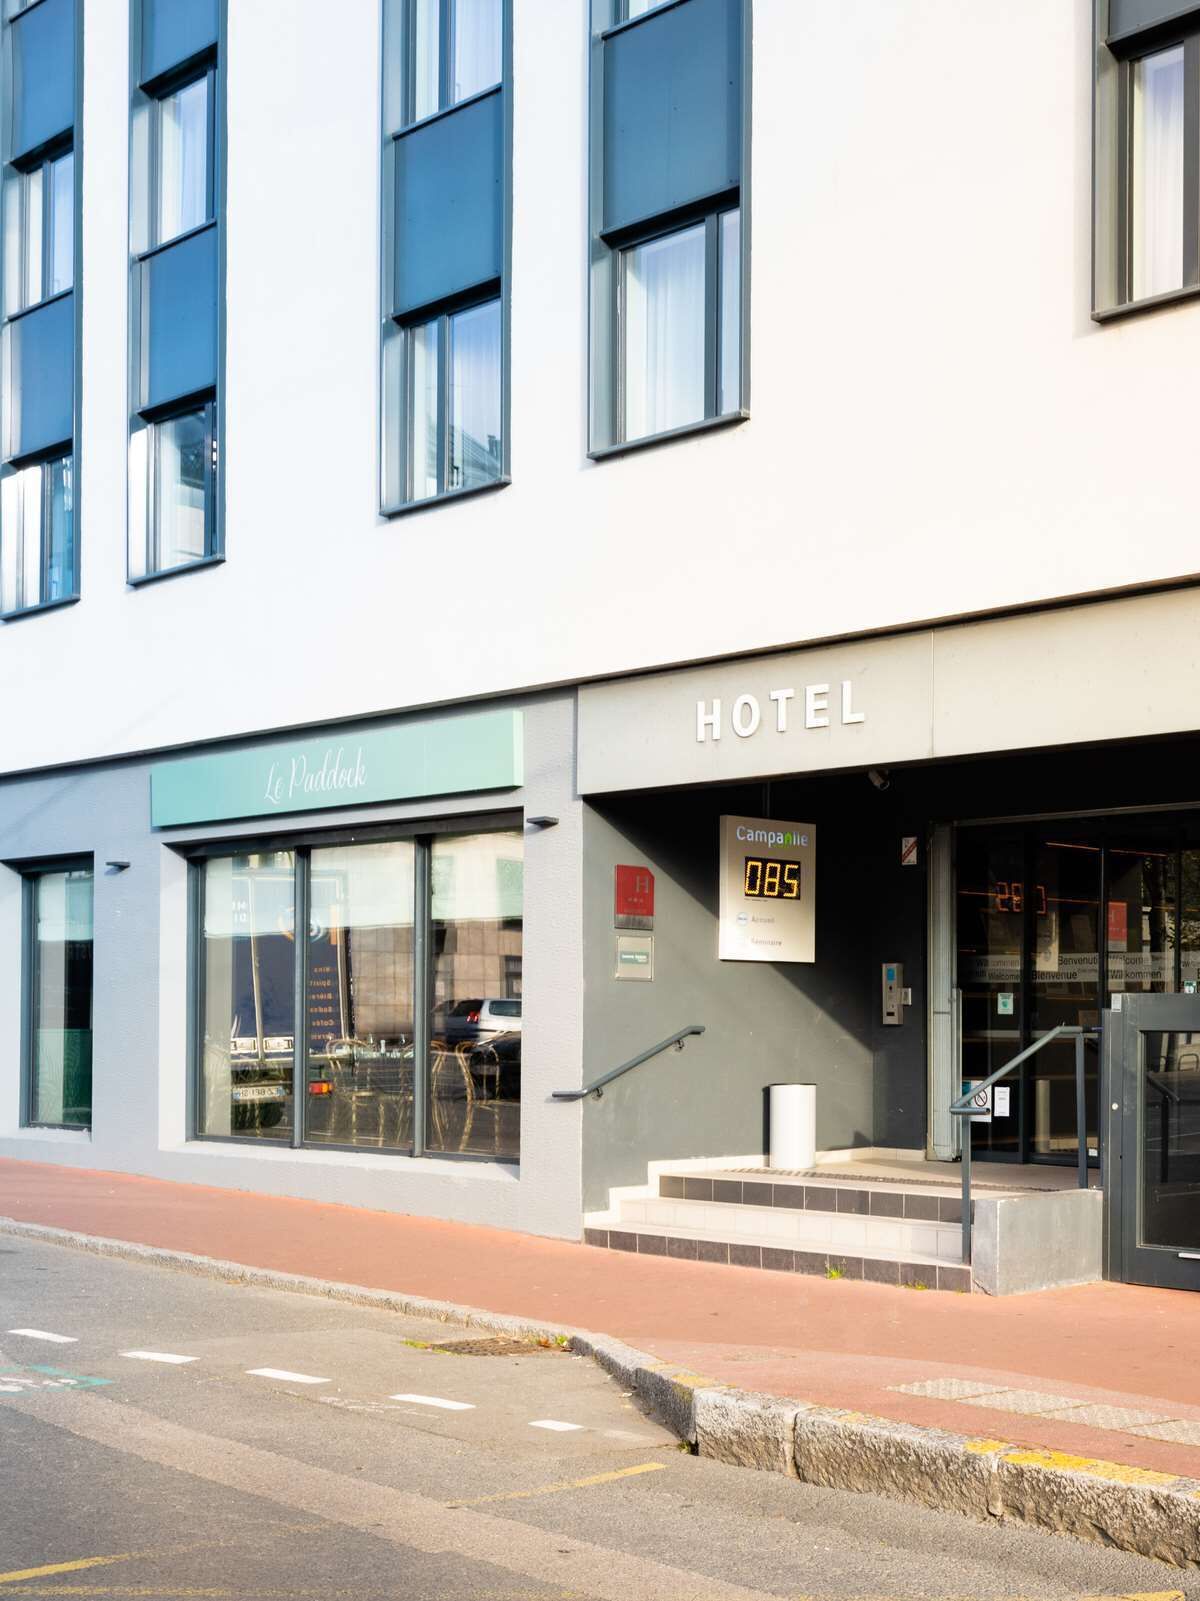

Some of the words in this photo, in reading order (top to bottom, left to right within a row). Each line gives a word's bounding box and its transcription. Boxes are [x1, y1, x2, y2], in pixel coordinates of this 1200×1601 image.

[696, 680, 865, 743] HOTEL
[264, 761, 282, 804] Le
[289, 746, 366, 799] Paddock
[736, 826, 808, 849] Campanile
[745, 861, 799, 897] 085
[1109, 969, 1162, 980] Wilkommen
